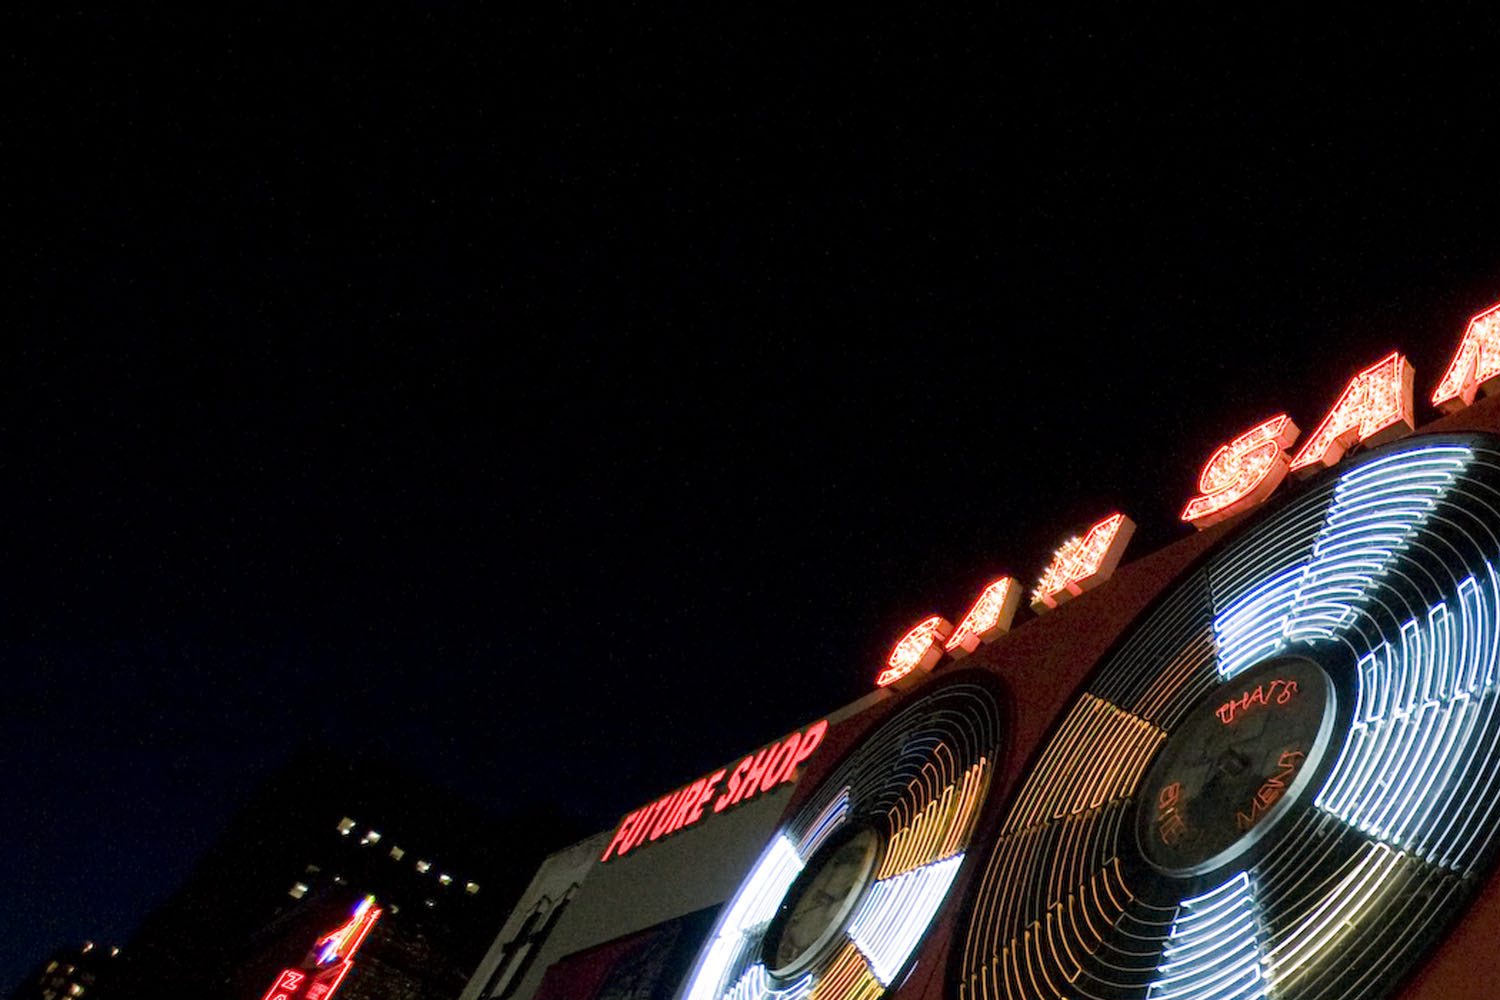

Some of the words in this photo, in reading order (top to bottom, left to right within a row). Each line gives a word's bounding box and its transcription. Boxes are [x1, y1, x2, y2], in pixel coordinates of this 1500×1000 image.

[876, 513, 1126, 689] SAM
[601, 768, 727, 863] FUTURE
[714, 719, 828, 814] SHOP
